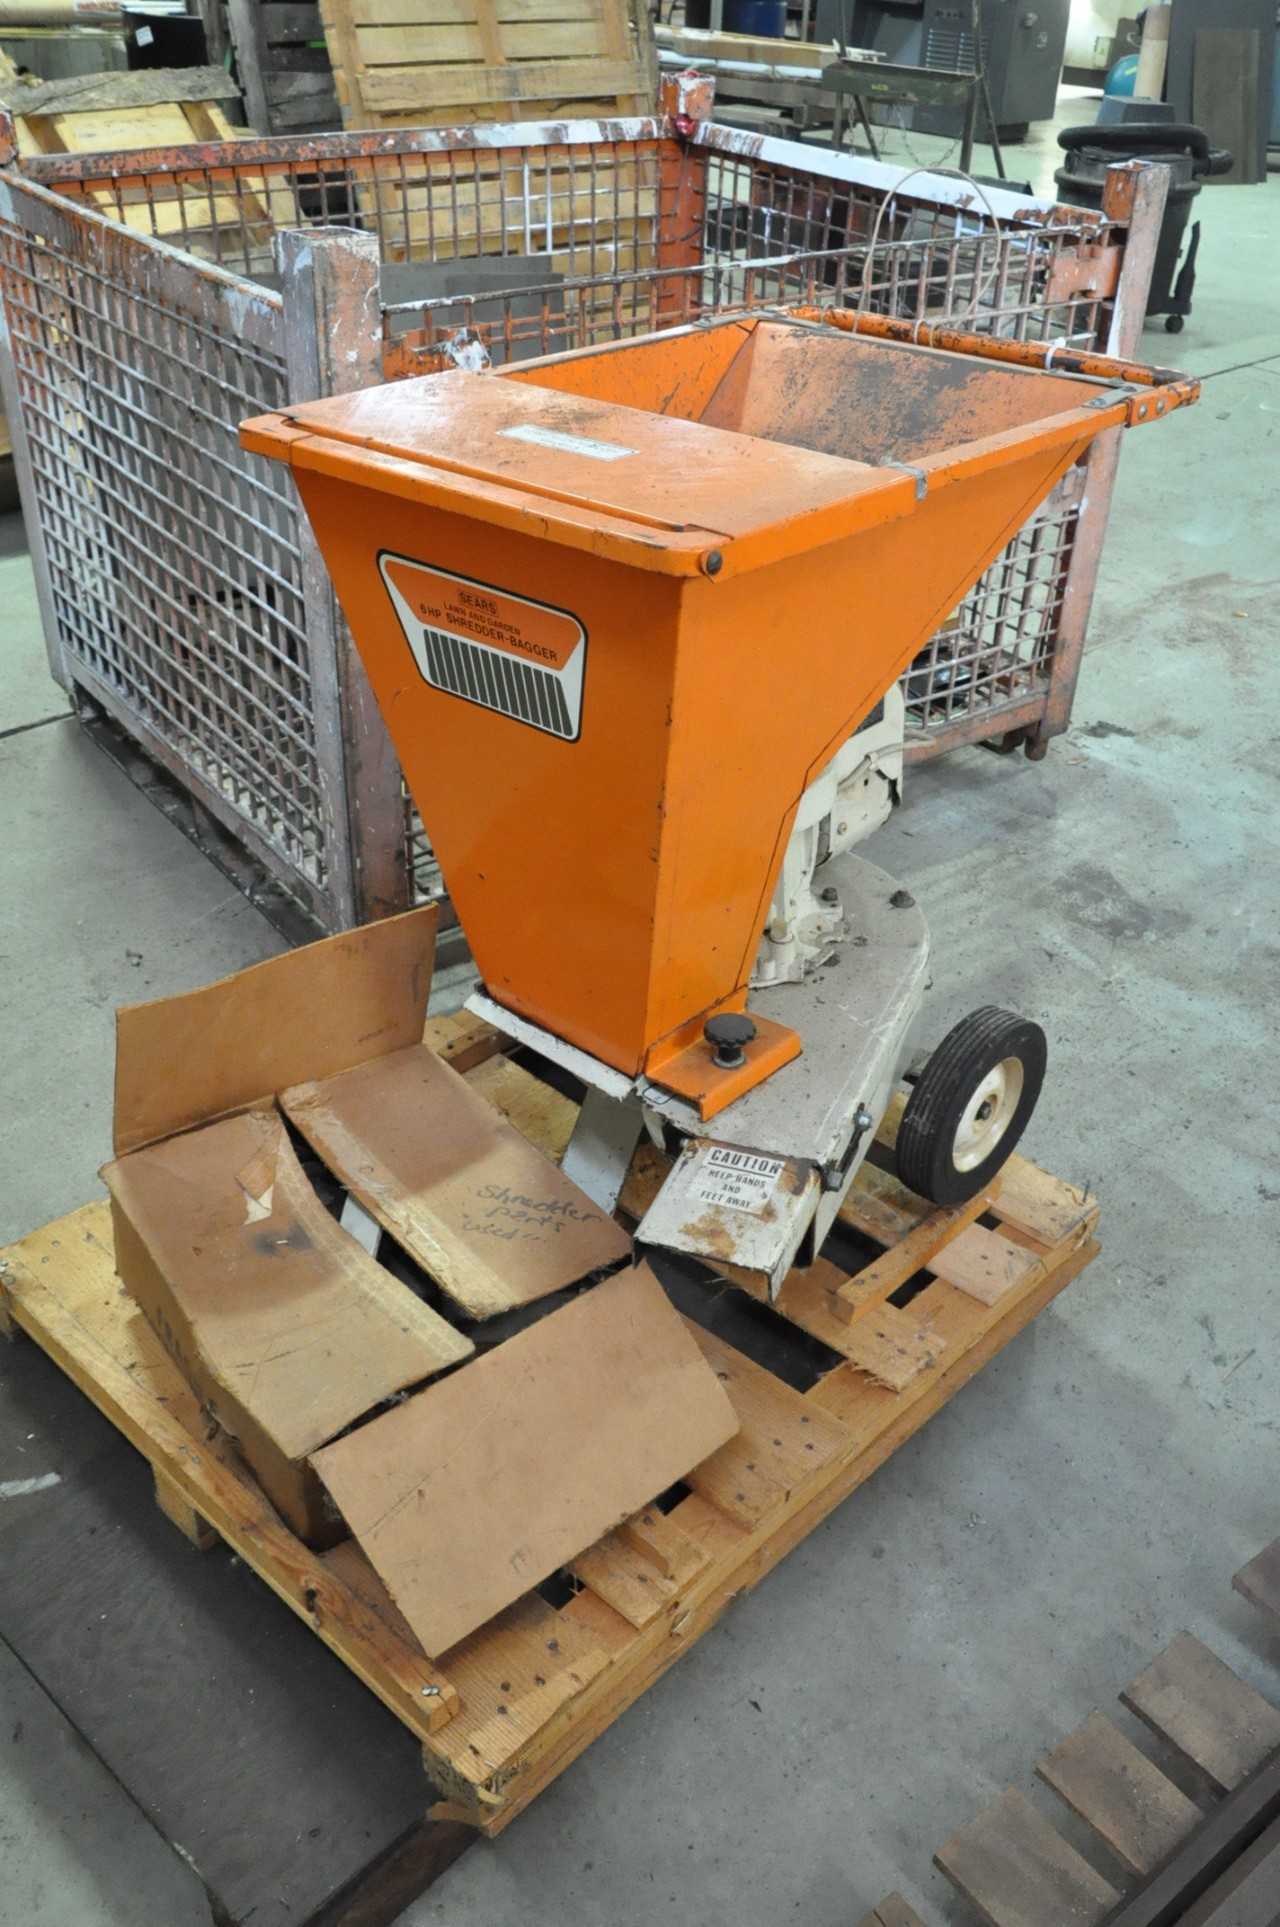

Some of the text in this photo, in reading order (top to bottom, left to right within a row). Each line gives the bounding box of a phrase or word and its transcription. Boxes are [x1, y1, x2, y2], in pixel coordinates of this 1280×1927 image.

[459, 591, 497, 615] SEARS
[443, 601, 521, 636] LAWN AND GARDEN
[446, 612, 559, 662] SHREDDER-BAGGER
[711, 1149, 782, 1175] CAUTION
[708, 1169, 767, 1188] KEEP HANDS
[722, 1183, 741, 1194] AND
[700, 1190, 751, 1208] FEET AWAY
